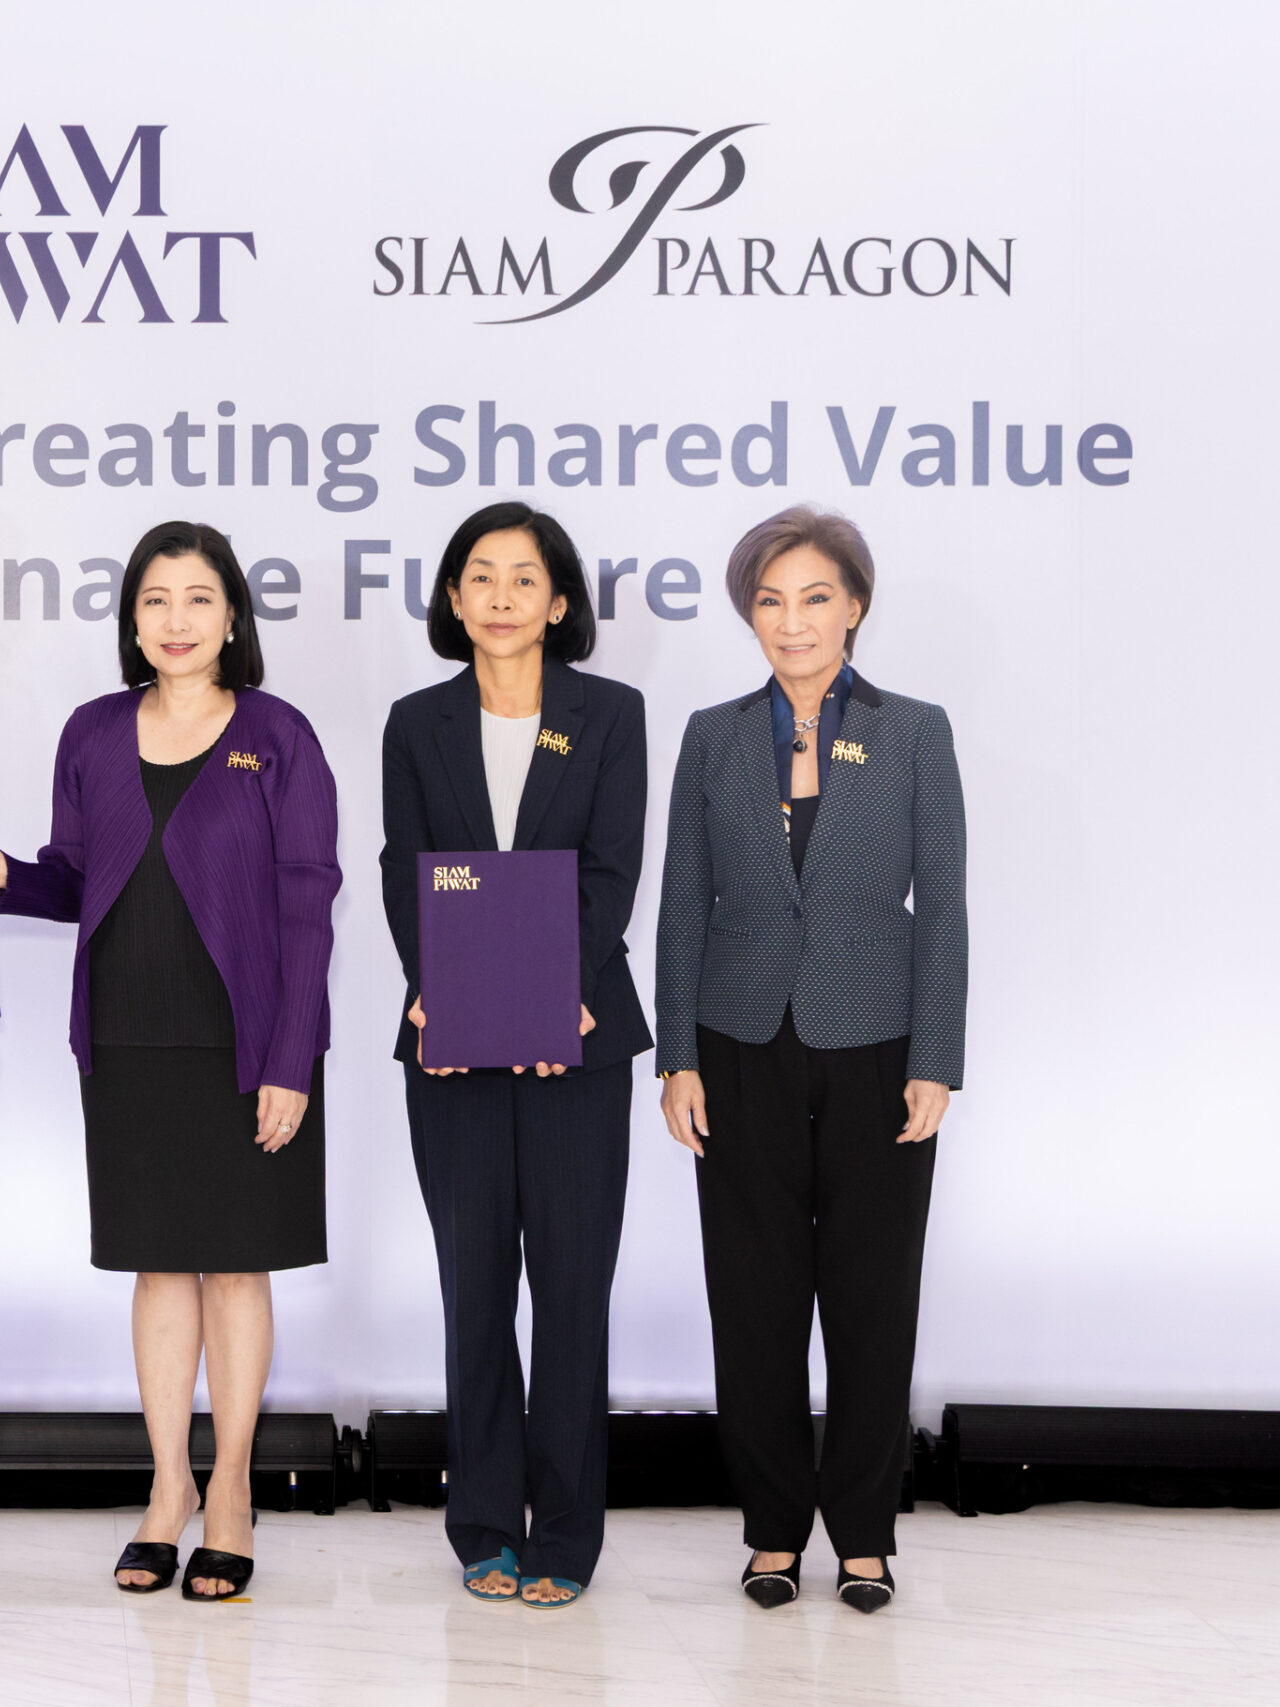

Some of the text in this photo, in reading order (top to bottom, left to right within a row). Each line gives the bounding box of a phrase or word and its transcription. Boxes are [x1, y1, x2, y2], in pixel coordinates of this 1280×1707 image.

[373, 236, 562, 296] SIAM
[652, 237, 1017, 297] PARAGON
[413, 401, 789, 487] Shared
[825, 401, 1134, 487] Value
[343, 539, 702, 621] Fure
[433, 866, 470, 878] SIAM
[433, 877, 481, 891] PIWAT
